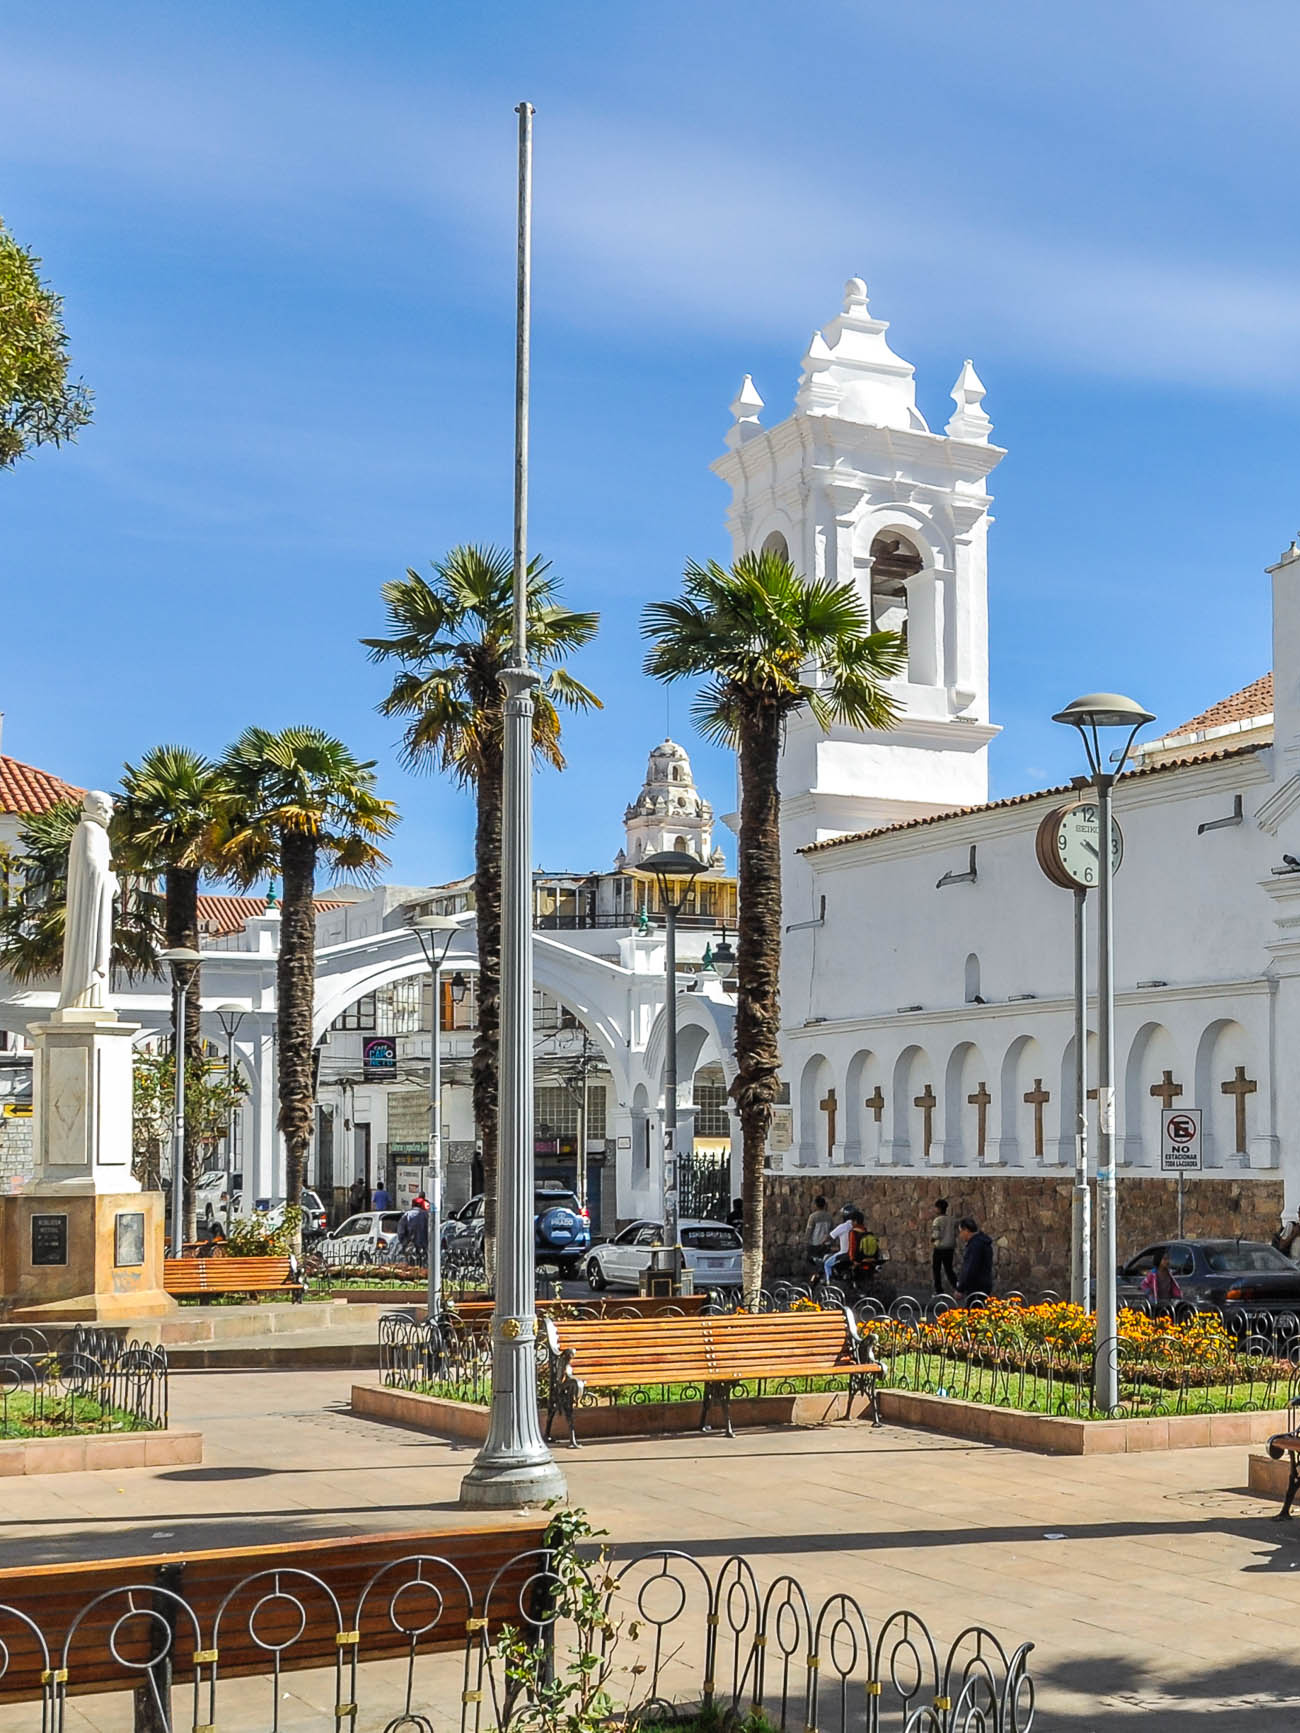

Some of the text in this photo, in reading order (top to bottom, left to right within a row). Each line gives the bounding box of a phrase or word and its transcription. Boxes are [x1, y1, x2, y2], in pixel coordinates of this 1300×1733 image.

[1081, 807, 1095, 823] 12
[1058, 835, 1067, 850] 9
[1111, 839, 1119, 855] 3
[1084, 867, 1094, 882] 6
